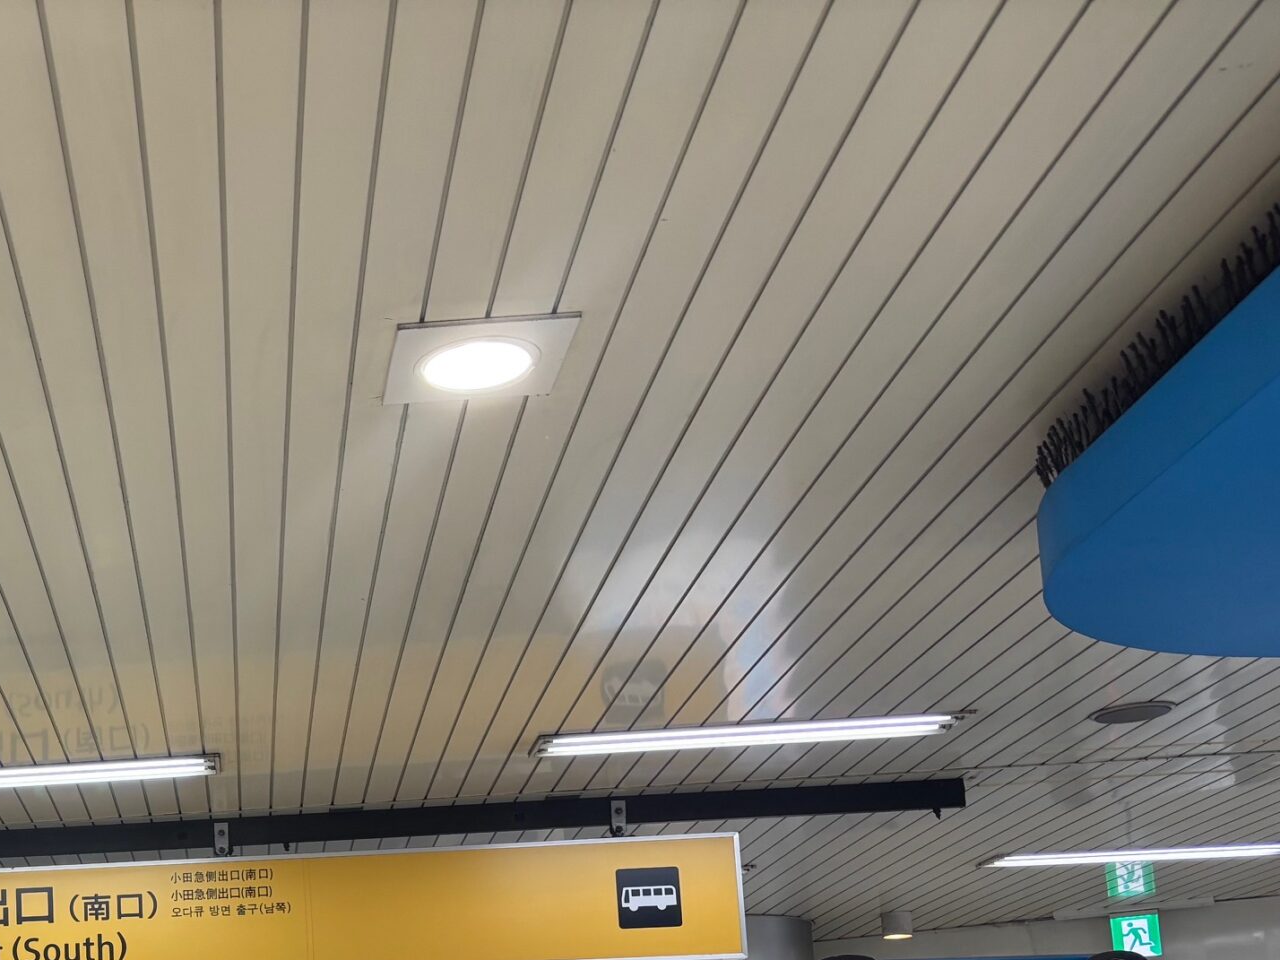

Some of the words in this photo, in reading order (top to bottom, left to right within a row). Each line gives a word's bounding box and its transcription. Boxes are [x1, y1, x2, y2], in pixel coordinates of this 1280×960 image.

[171, 868, 274, 884] 小田急側出口(南口)
[171, 906, 204, 918] 오다큐
[209, 904, 231, 916] 방면
[236, 902, 291, 915] 출구(남쪽)
